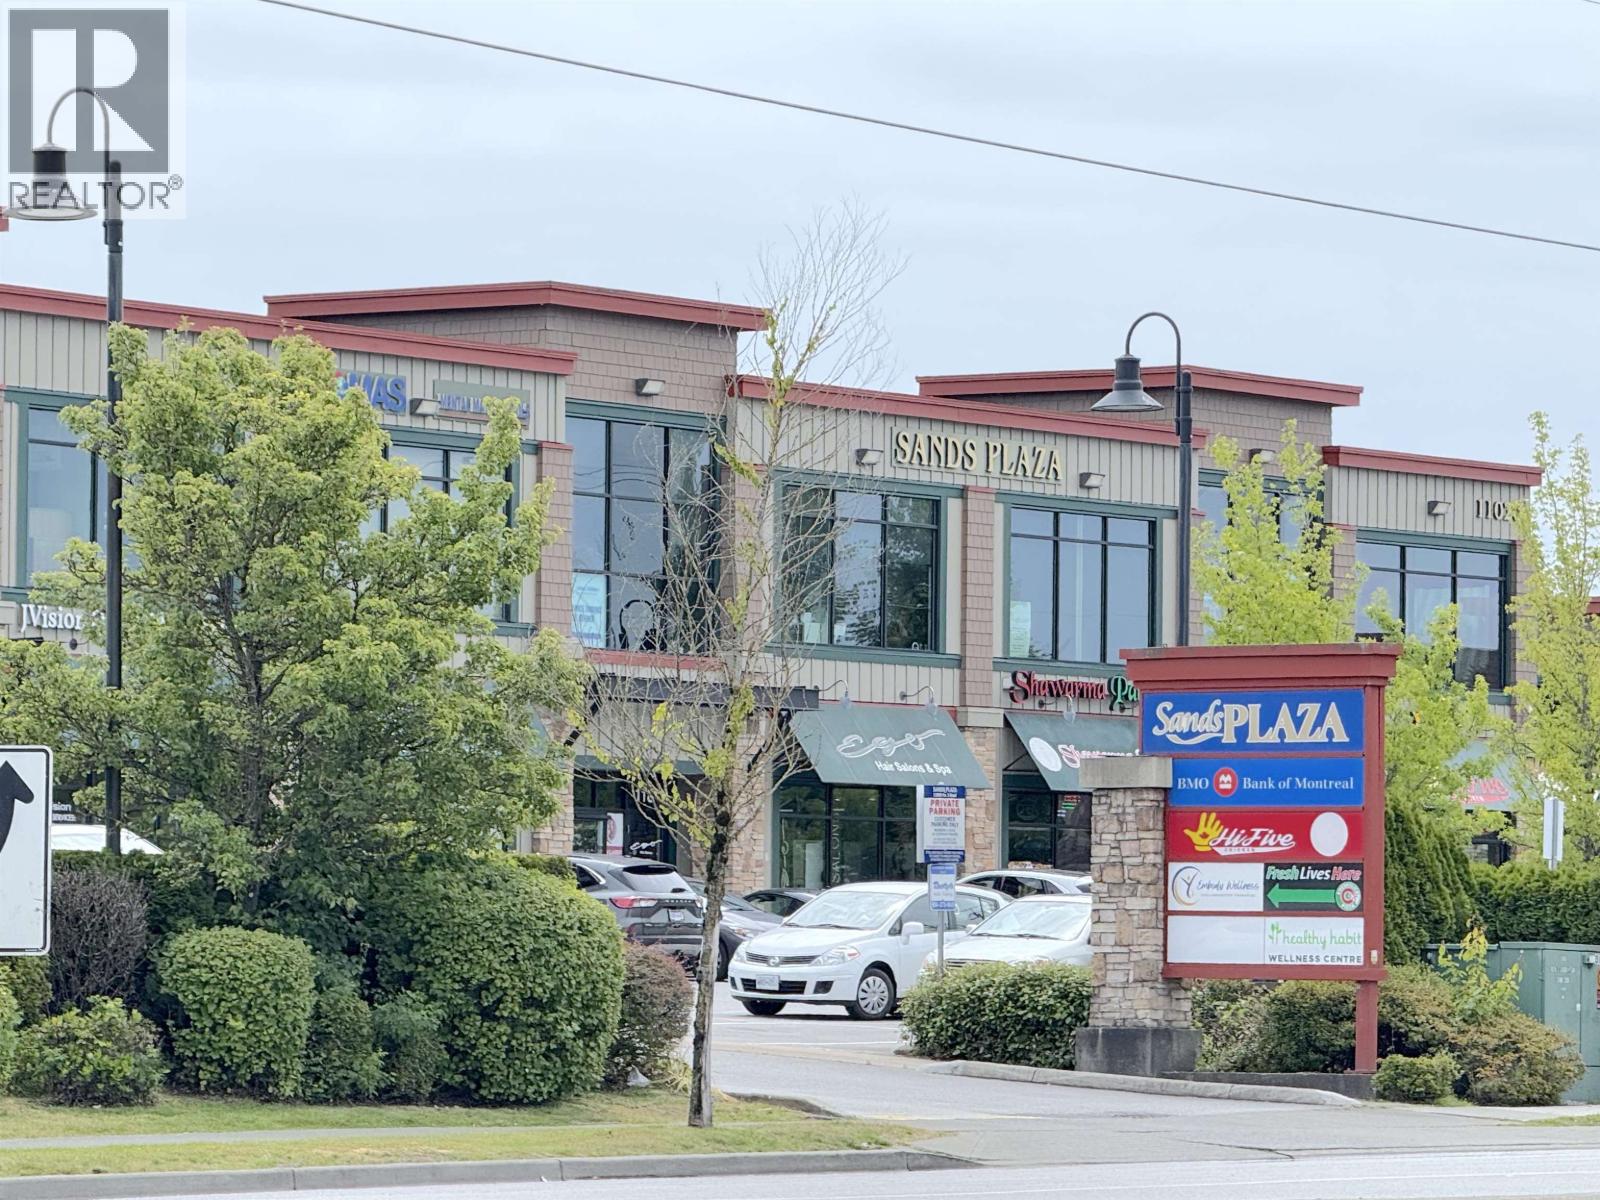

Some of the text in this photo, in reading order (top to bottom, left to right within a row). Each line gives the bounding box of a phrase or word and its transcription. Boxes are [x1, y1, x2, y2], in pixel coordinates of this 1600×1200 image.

[895, 431, 1063, 480] SANDS PLAZA
[1009, 671, 1107, 704] Shawarma
[1152, 699, 1350, 745] Sands PLAZA
[875, 760, 952, 776] Hair Salons & Spa
[1177, 777, 1355, 790] BMO Bank of Montreal
[929, 808, 961, 816] PARKING
[930, 800, 960, 808] PRIVATE
[1266, 865, 1362, 881] Fresh Lives Here
[1282, 929, 1361, 950] healthy habit
[1268, 955, 1361, 963] WELLNESS CENTRE
